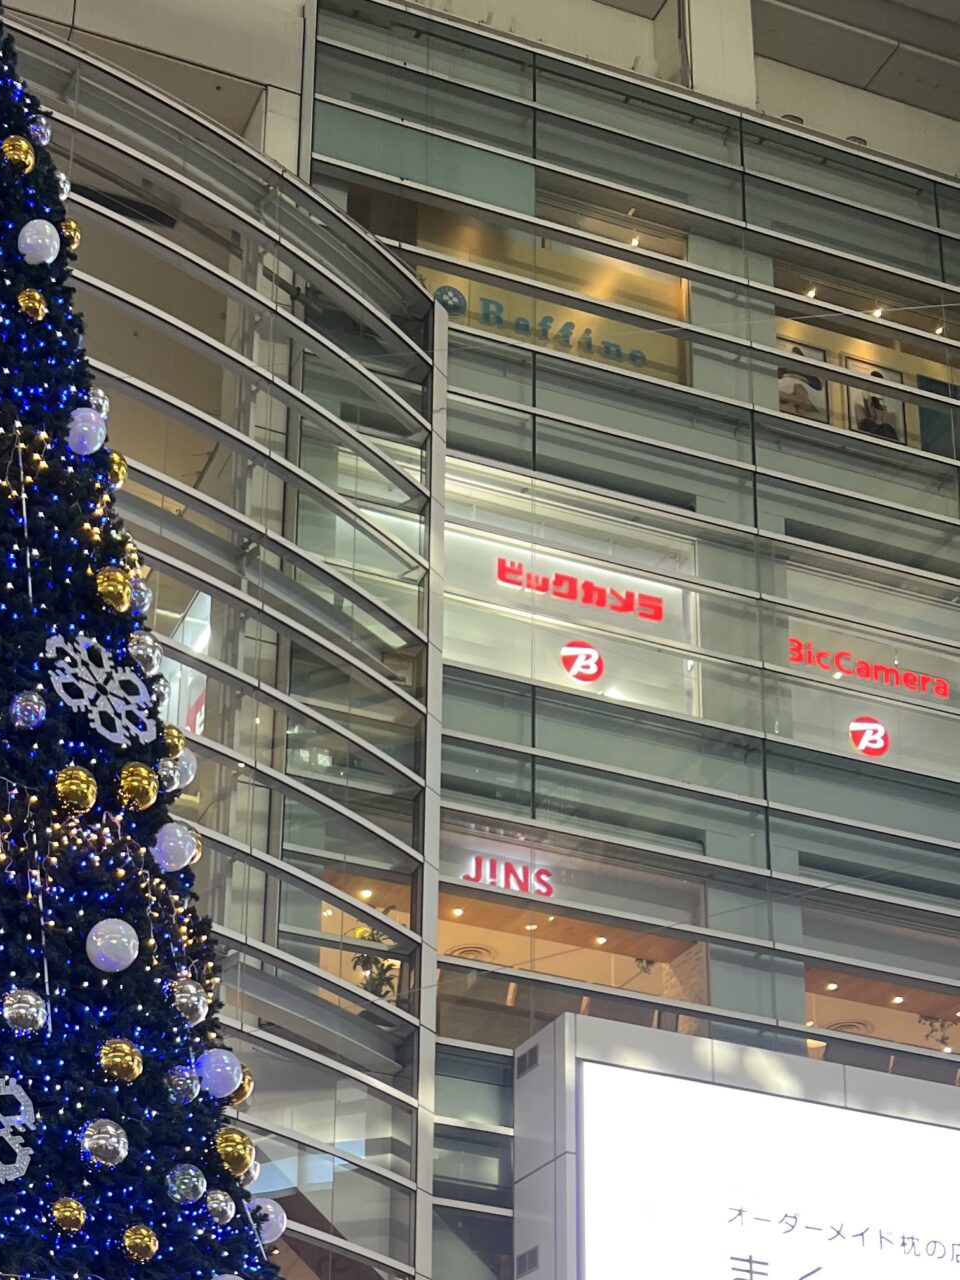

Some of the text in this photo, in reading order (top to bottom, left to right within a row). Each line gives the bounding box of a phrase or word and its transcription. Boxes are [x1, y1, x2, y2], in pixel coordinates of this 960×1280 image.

[496, 557, 664, 622] ビックカメラ
[787, 636, 950, 699] BicCamera
